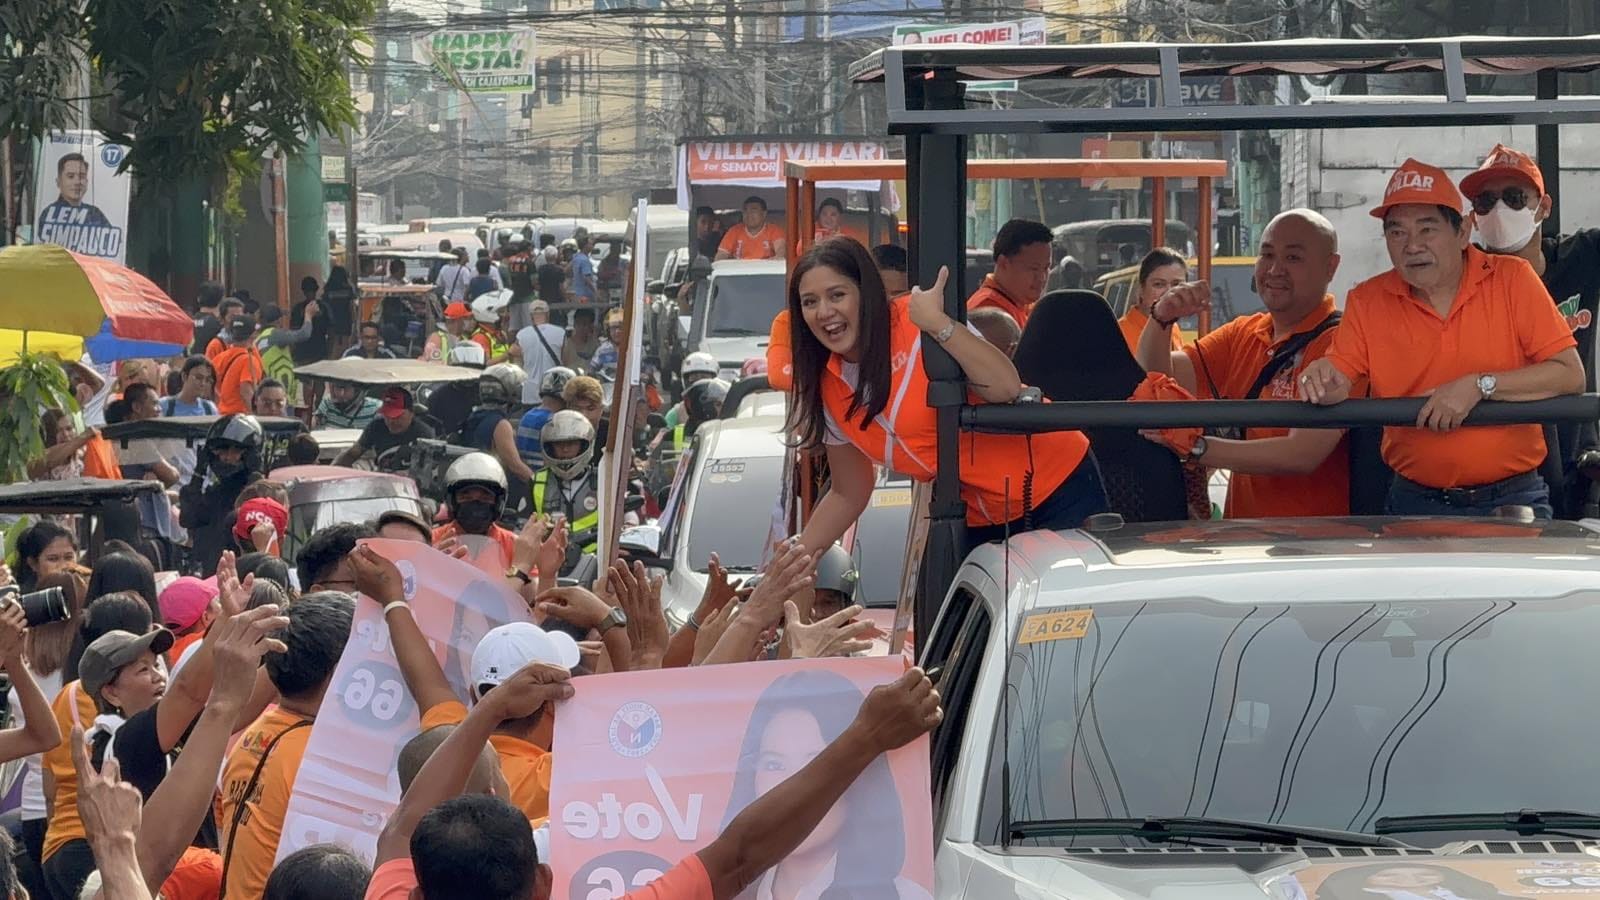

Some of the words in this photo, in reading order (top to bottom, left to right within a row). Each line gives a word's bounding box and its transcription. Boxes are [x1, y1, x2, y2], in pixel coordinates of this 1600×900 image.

[432, 31, 516, 49] HAPPY
[1180, 83, 1222, 100] ave
[105, 148, 119, 162] 17
[704, 164, 719, 172] for
[46, 206, 88, 225] LEM
[41, 223, 121, 256] SIMPAUCO
